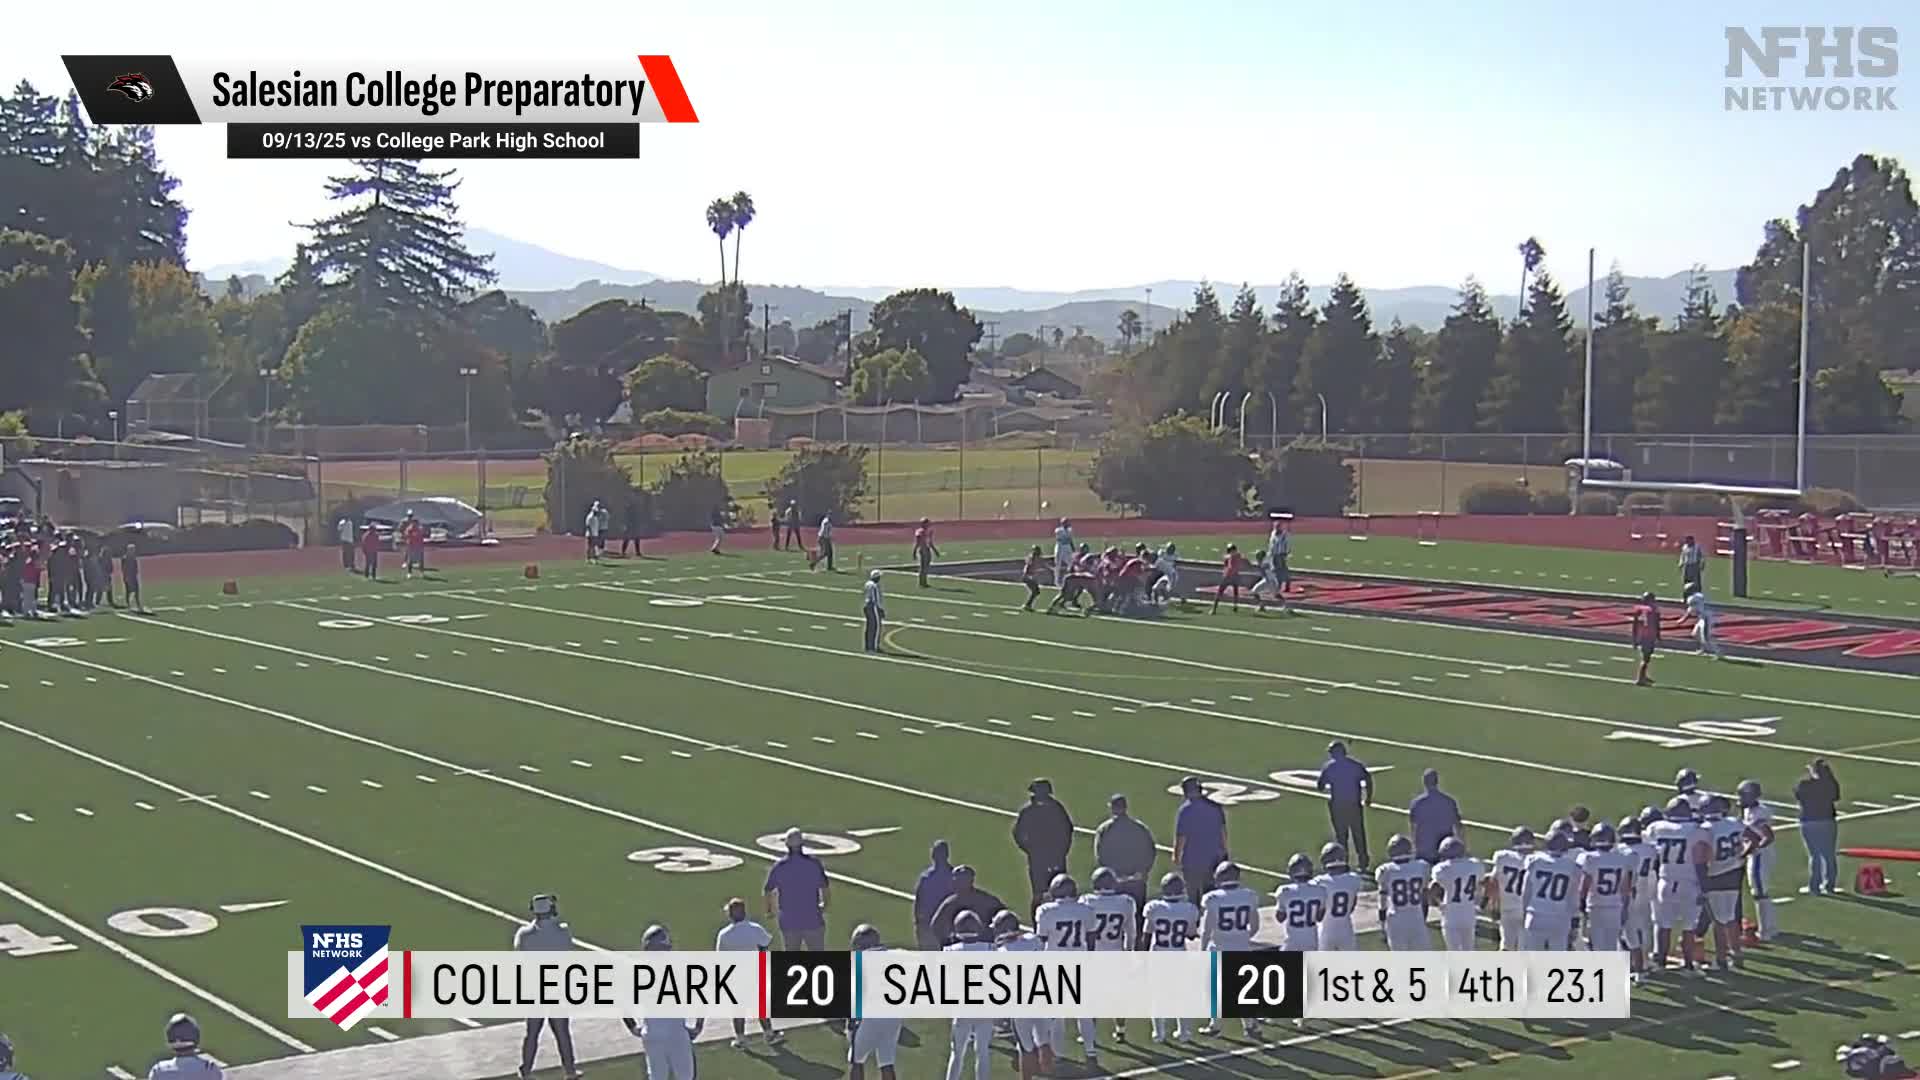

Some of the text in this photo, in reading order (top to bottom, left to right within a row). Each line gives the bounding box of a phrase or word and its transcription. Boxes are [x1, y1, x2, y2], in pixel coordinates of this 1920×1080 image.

[1657, 838, 1687, 864] 77
[1392, 877, 1423, 906] 88
[1452, 875, 1477, 902] 14
[1536, 870, 1570, 901] 70
[1289, 899, 1321, 928] 20
[1331, 892, 1349, 917] 8
[1056, 920, 1082, 947] 71
[1095, 913, 1124, 940] 73
[1156, 918, 1188, 948] 28
